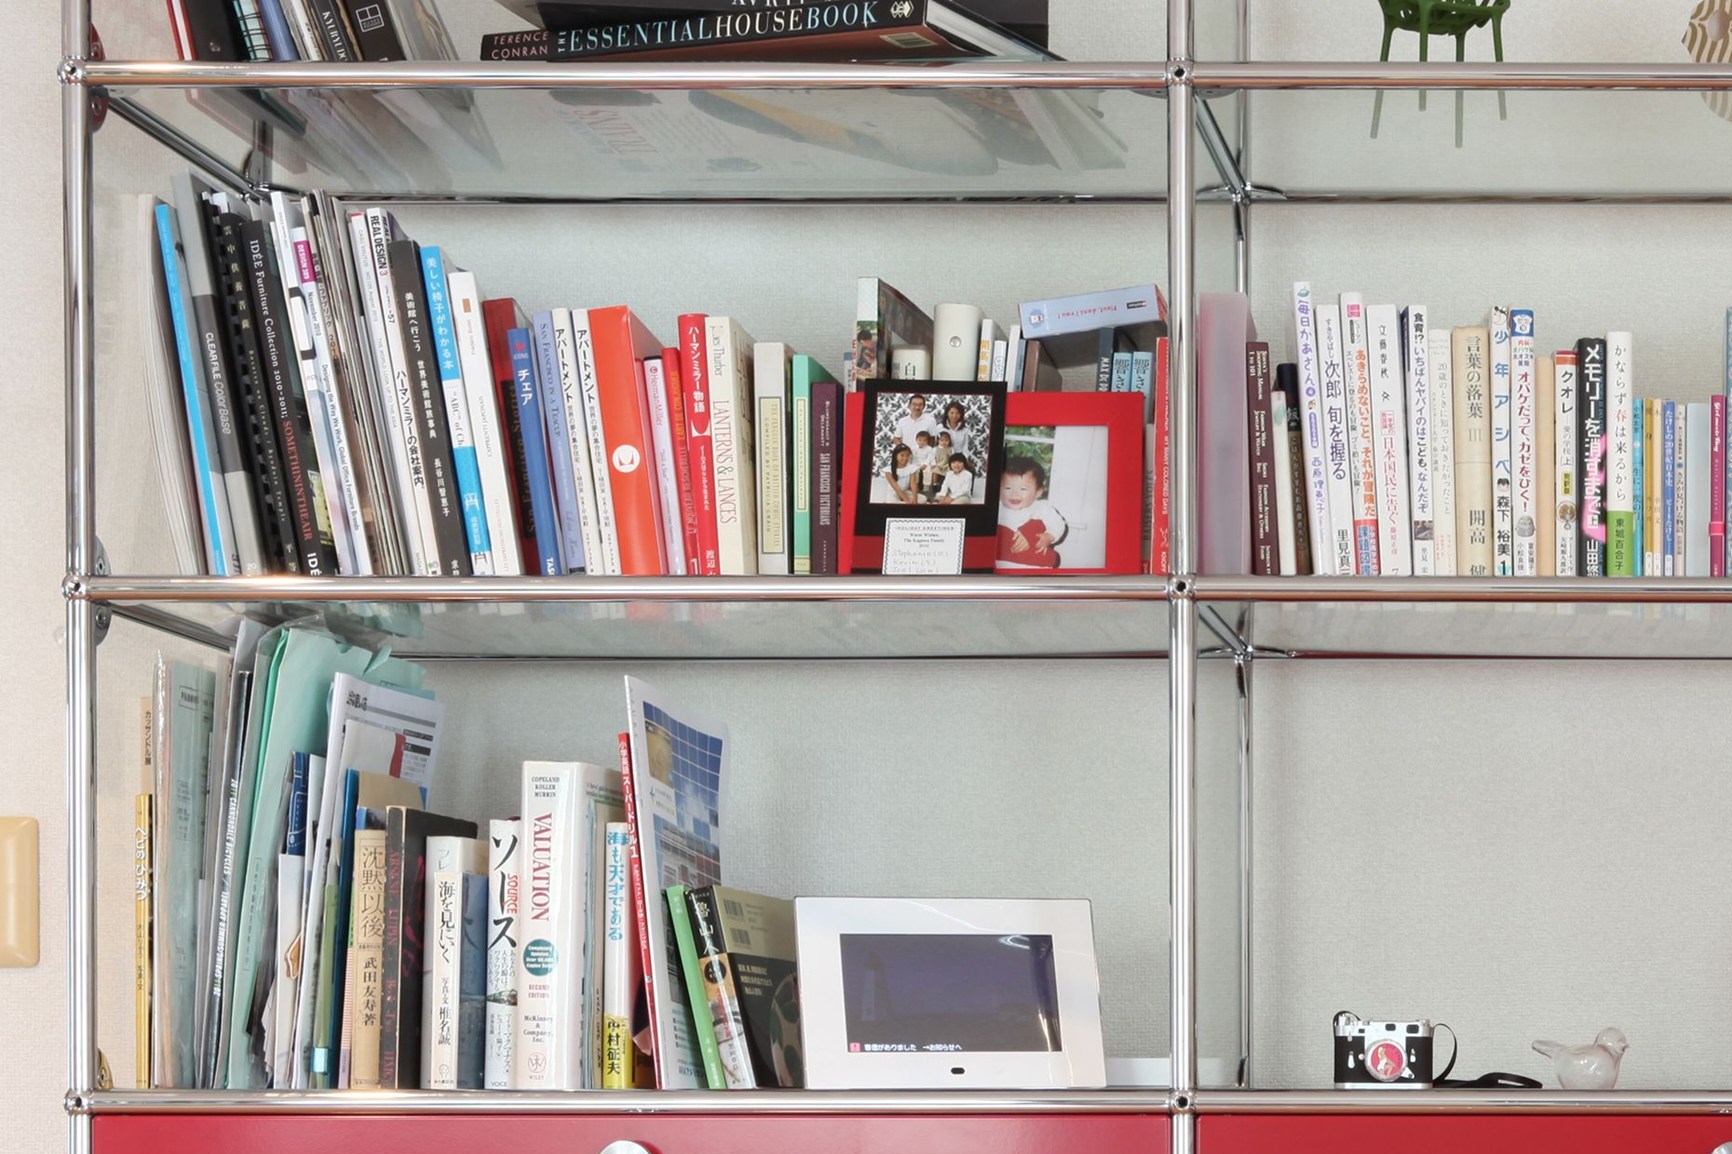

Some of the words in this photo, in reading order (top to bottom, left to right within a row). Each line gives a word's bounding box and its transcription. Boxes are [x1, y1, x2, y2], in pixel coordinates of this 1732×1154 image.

[492, 31, 548, 45] TERENCE
[492, 46, 548, 59] CONRAN
[556, 328, 573, 402] アパートメント
[577, 328, 594, 403] アパートメント
[1298, 300, 1315, 386] 毎日かあさん
[517, 369, 533, 406] チェア
[1494, 331, 1511, 475] 少年アシベ
[1614, 344, 1627, 502] かならず春は来るから
[713, 400, 734, 462] LANTERNS
[719, 477, 737, 524] LANCES
[1614, 517, 1624, 570] 東城百合子
[361, 847, 384, 939] 沈黙以後
[488, 834, 519, 950] ソース
[506, 873, 519, 915] SOURCE
[531, 812, 553, 922] VALUATION
[608, 832, 629, 942] 海も天才である
[438, 881, 456, 964] 海を見にいく
[438, 1006, 452, 1046] 椎名誠
[606, 1019, 621, 1075] 中村征夫
